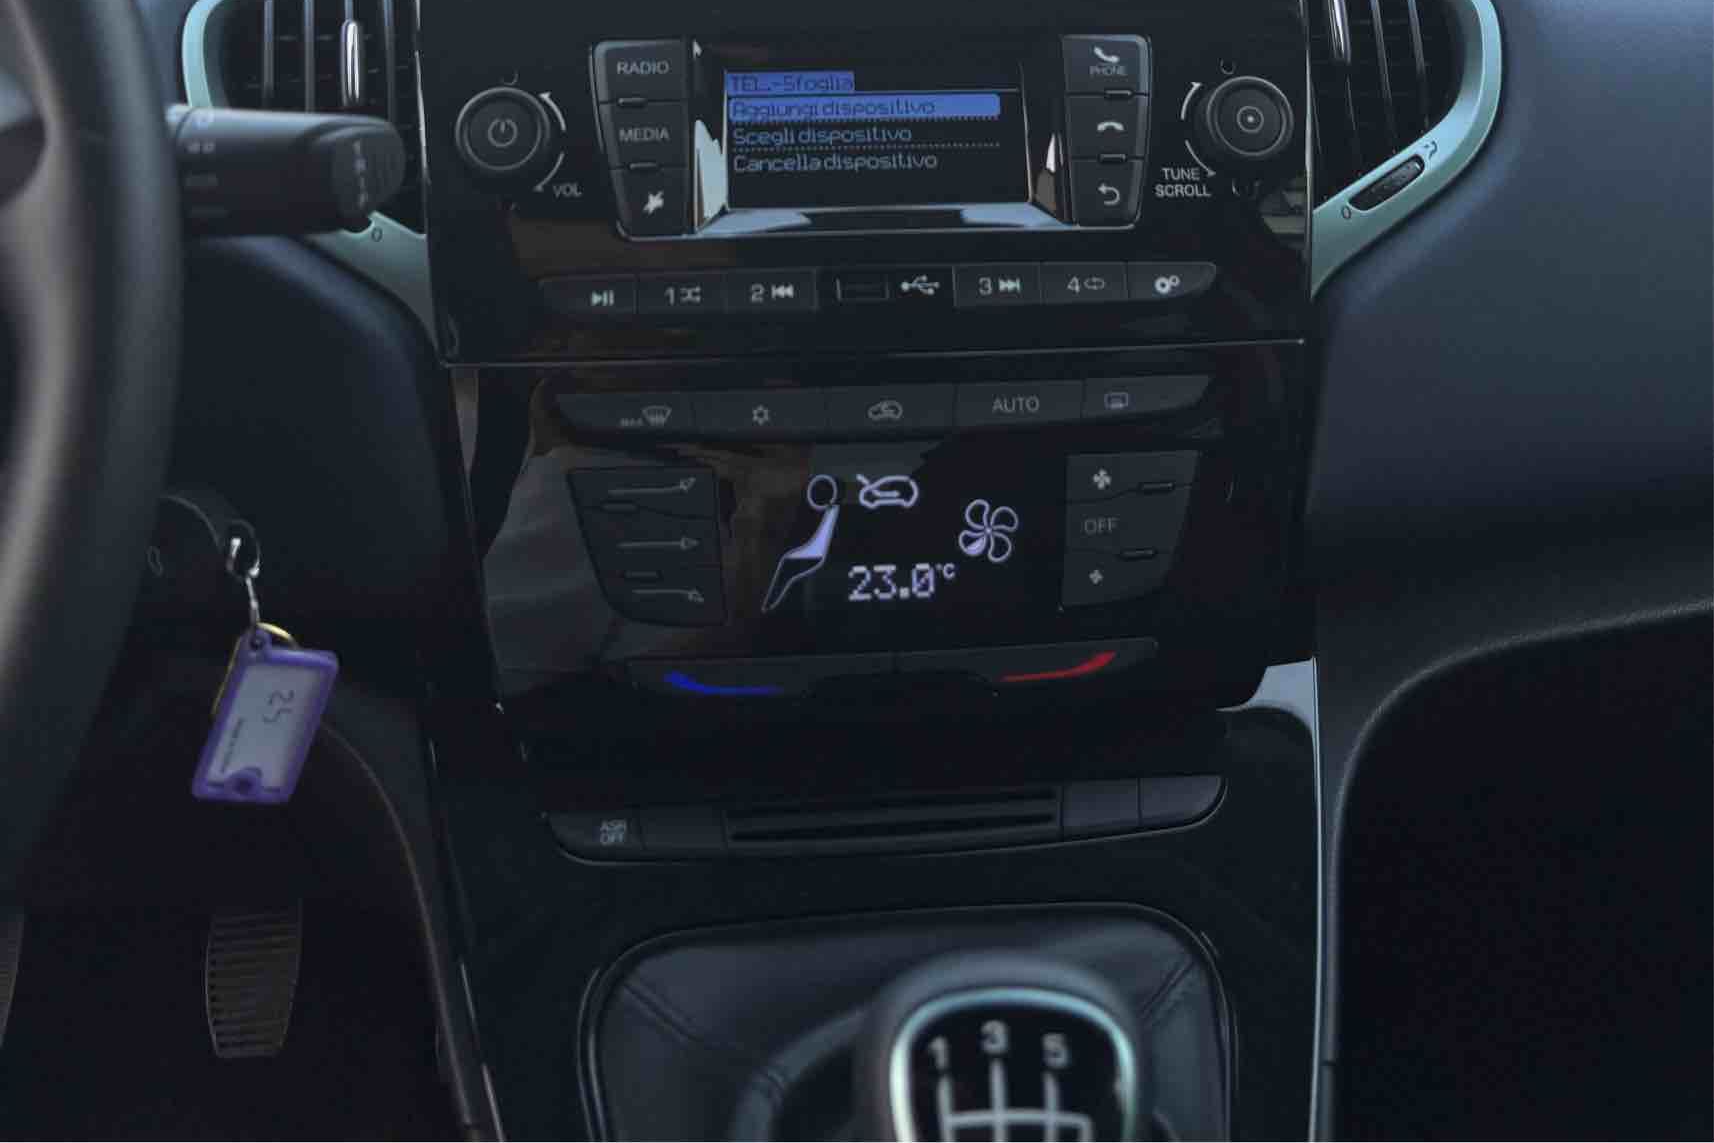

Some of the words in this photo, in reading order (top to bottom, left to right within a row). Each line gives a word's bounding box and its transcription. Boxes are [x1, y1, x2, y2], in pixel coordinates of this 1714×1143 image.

[617, 60, 669, 75] RADIO
[1089, 65, 1127, 77] PHONE
[733, 100, 820, 121] Aggiungi
[823, 98, 936, 119] dispositivo
[619, 127, 670, 142] MEDIA
[733, 127, 796, 148] Scegli
[798, 125, 912, 145] dispositivo
[733, 154, 821, 173] Cancella
[823, 153, 938, 173] dispositivo
[1162, 167, 1200, 180] TUNE
[553, 183, 583, 197] VOL
[1154, 183, 1212, 197] SCROLL
[751, 284, 766, 303] 2
[978, 277, 992, 295] 3
[1066, 276, 1081, 294] 4
[664, 287, 676, 306] 1
[992, 395, 1040, 414] AUTO
[1084, 517, 1119, 534] OFF
[980, 1020, 1009, 1055] 3
[927, 1036, 949, 1070] 1
[1041, 1032, 1069, 1069] 5
